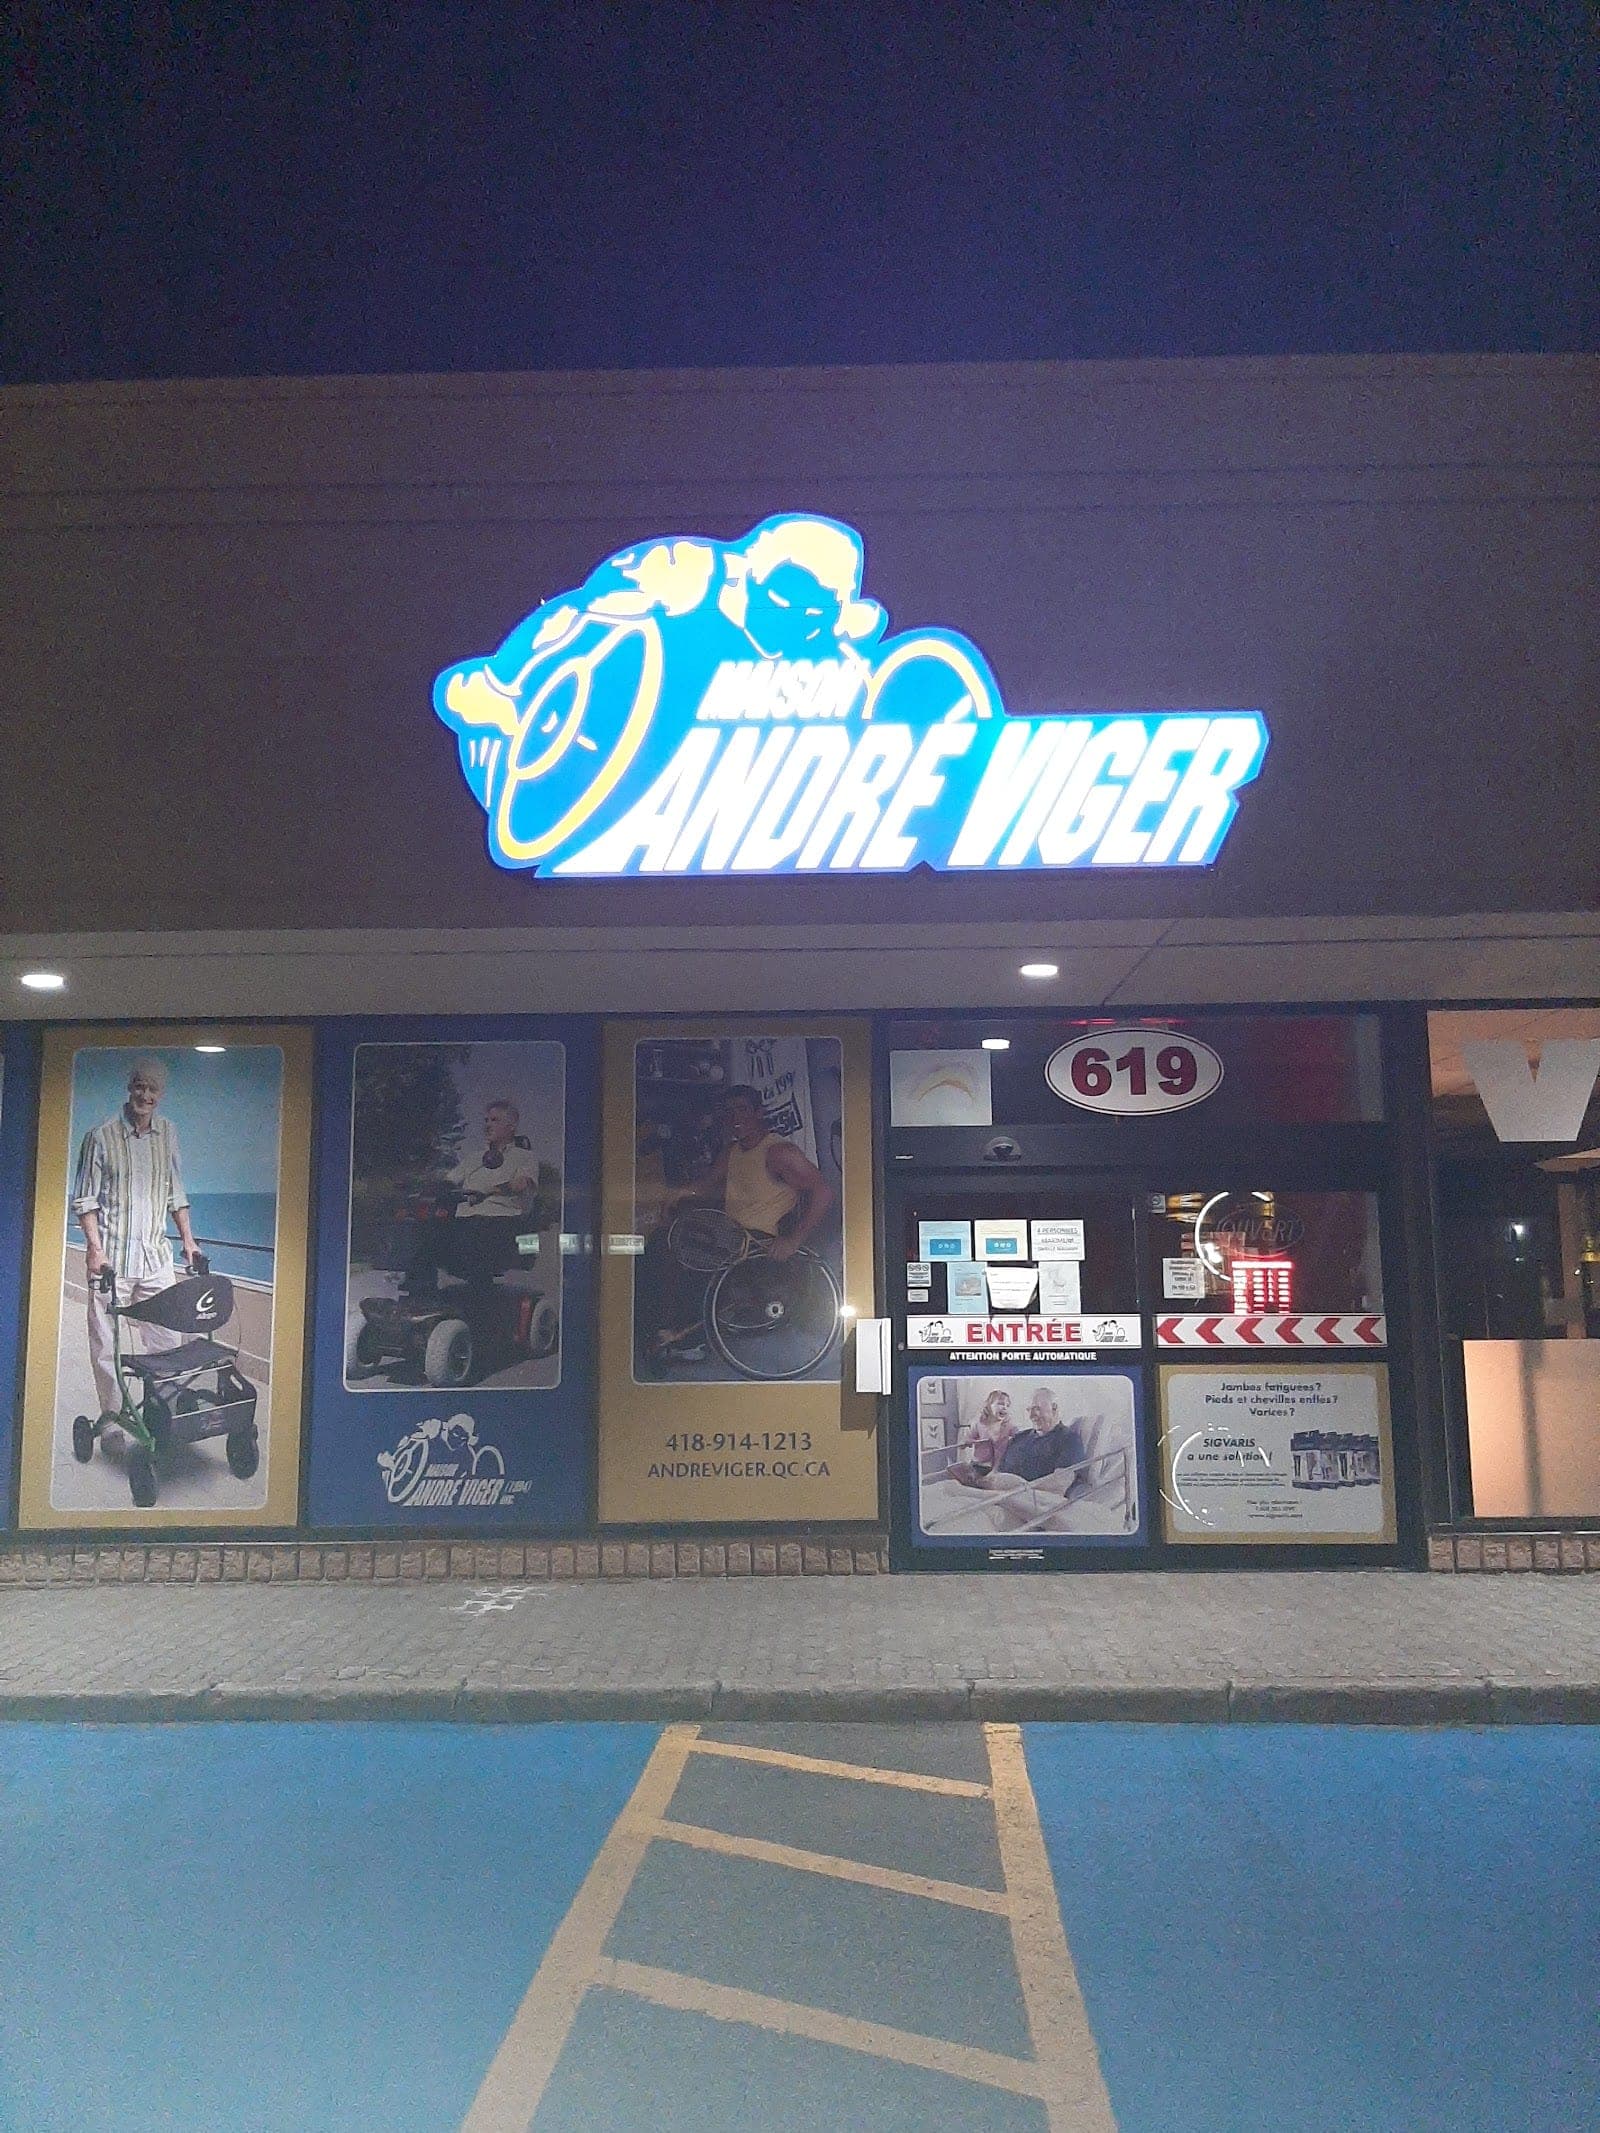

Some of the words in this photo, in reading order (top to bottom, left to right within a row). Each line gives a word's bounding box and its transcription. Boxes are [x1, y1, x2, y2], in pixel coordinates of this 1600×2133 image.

[695, 658, 872, 720] MAISON
[552, 702, 978, 873] ANDRÉ
[946, 716, 1261, 868] VIGER
[1070, 1045, 1198, 1097] 619
[966, 1317, 1083, 1343] ENTRÉE
[949, 1351, 1000, 1361] ATTENTION
[1001, 1351, 1031, 1361] PORTE
[1032, 1351, 1097, 1361] AUTOMATIQUE
[1220, 1381, 1261, 1391] Jambes
[1205, 1394, 1233, 1404] Pieds
[1236, 1395, 1247, 1404] et
[1250, 1394, 1296, 1404] chevilles
[665, 1432, 812, 1451] 418-914-1213
[1203, 1438, 1256, 1448] SIGVARIS
[1198, 1453, 1219, 1461] une
[647, 1461, 831, 1480] ANDREVIGER.QC.CA
[402, 1471, 468, 1506] ANDRÉ
[459, 1478, 505, 1506] VIGER
